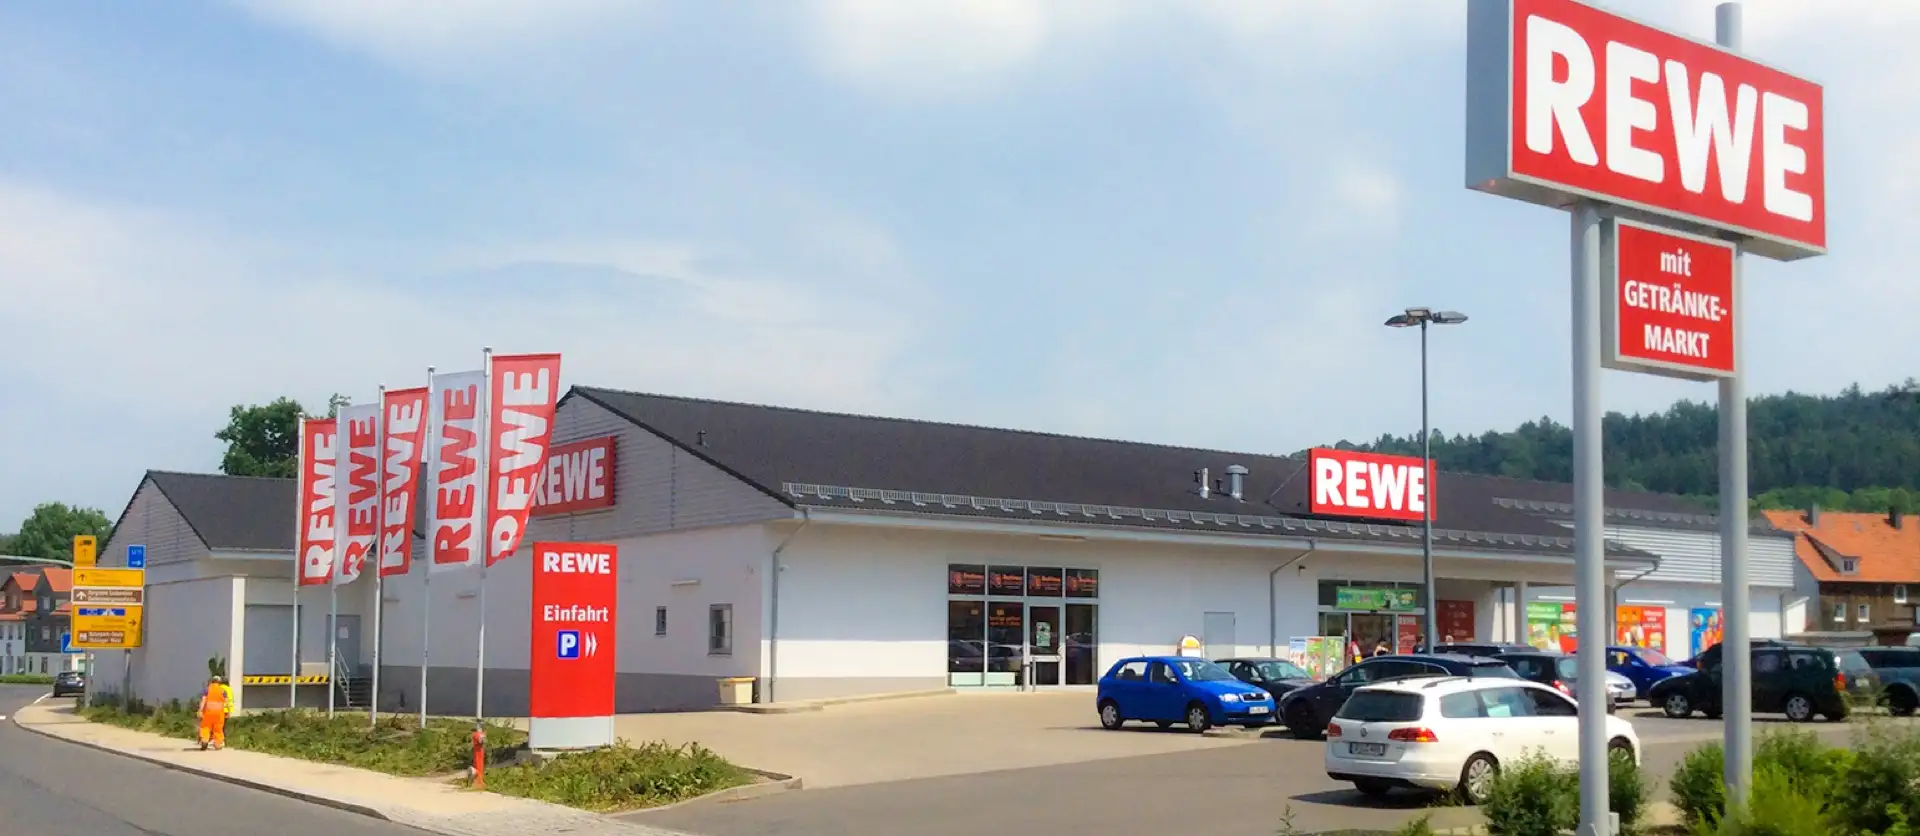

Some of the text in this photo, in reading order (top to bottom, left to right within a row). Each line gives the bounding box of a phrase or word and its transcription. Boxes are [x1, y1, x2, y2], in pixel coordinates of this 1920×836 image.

[1525, 14, 1814, 223] REWE
[1660, 248, 1692, 277] mit
[1624, 280, 1728, 322] GETRÄNKE-
[1644, 324, 1710, 359] MARKT
[342, 416, 376, 576] REWE
[381, 398, 423, 569] REWE
[434, 384, 478, 565] REWE
[1315, 457, 1425, 512] REWE
[304, 432, 337, 578] REWE
[543, 552, 611, 575] REWE
[543, 605, 609, 622] Einfahrt
[560, 633, 577, 656] P
